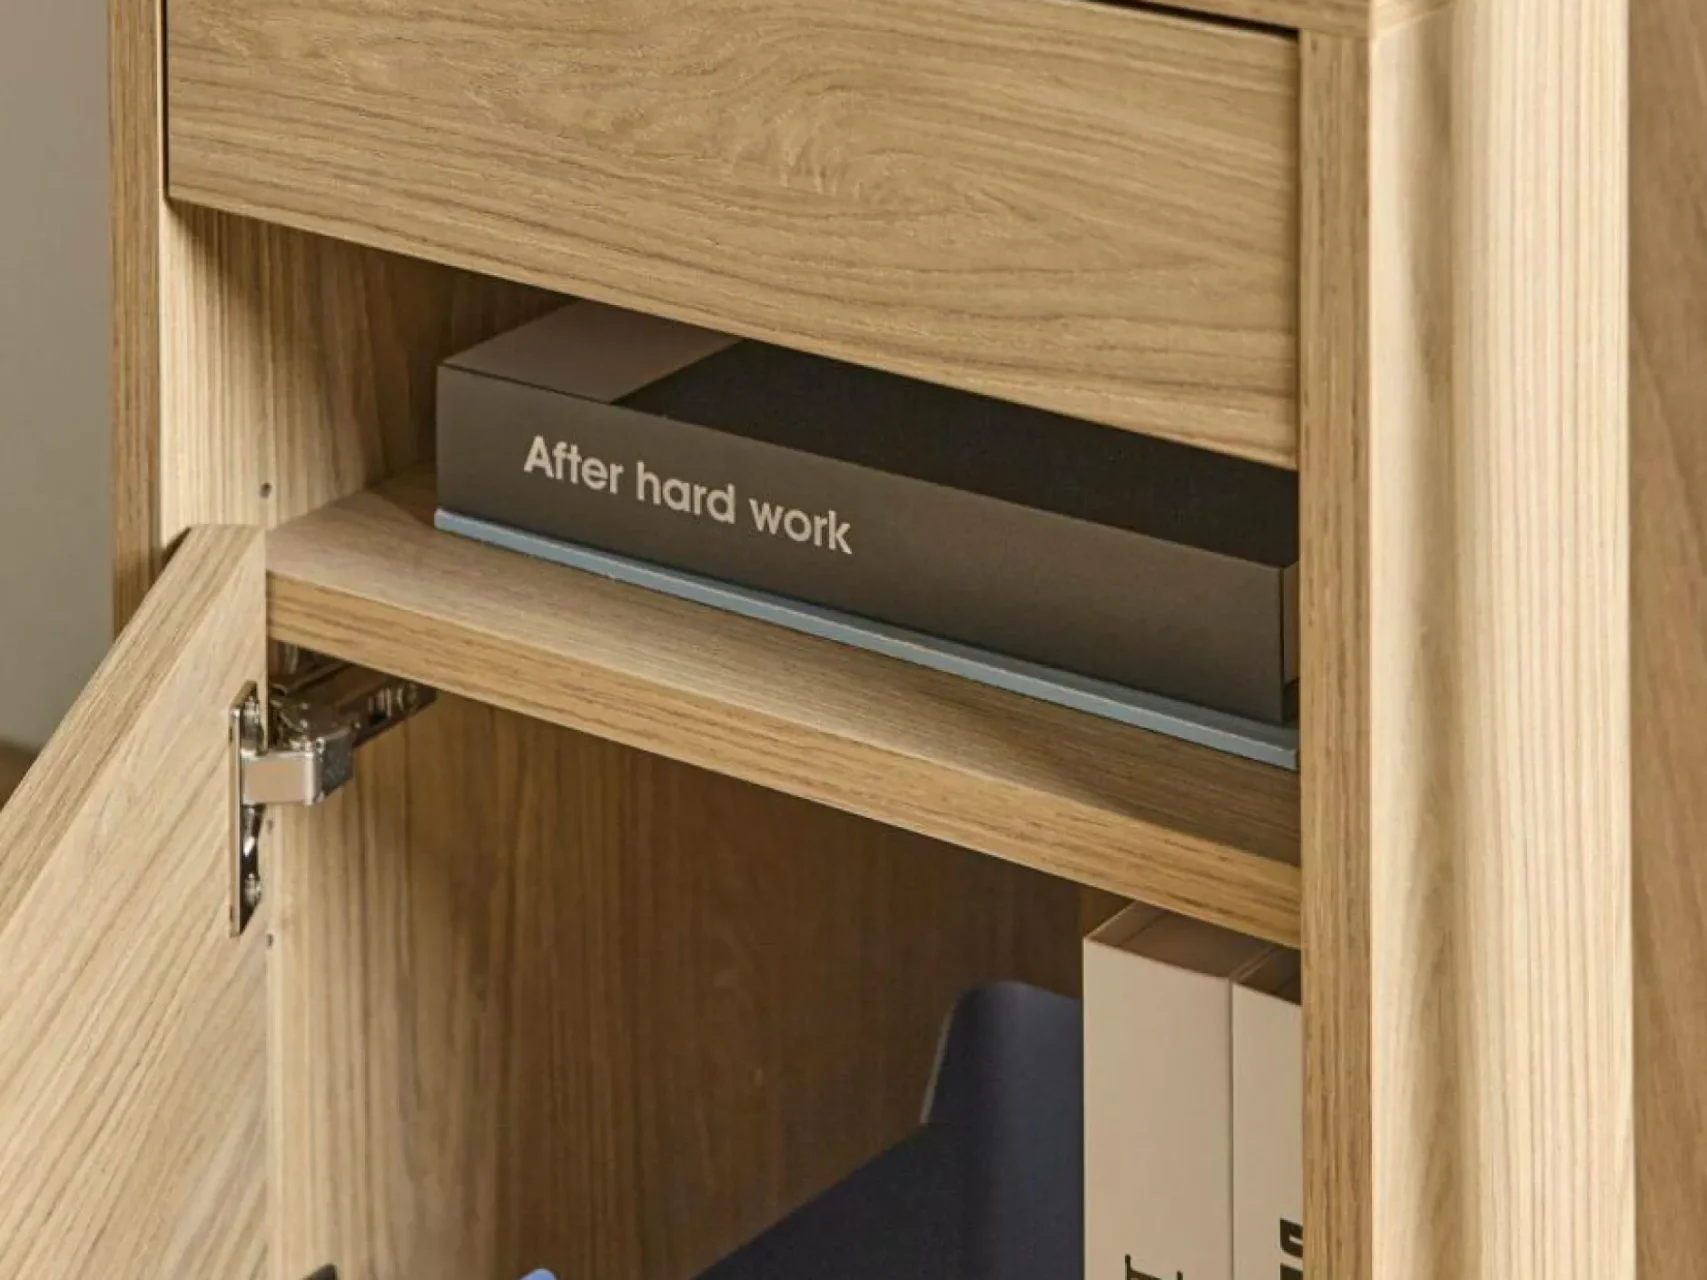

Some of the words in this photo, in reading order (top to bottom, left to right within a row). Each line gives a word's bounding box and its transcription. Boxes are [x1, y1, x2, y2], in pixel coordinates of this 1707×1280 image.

[523, 435, 624, 494] After
[636, 460, 735, 524] hard
[748, 497, 853, 554] work
